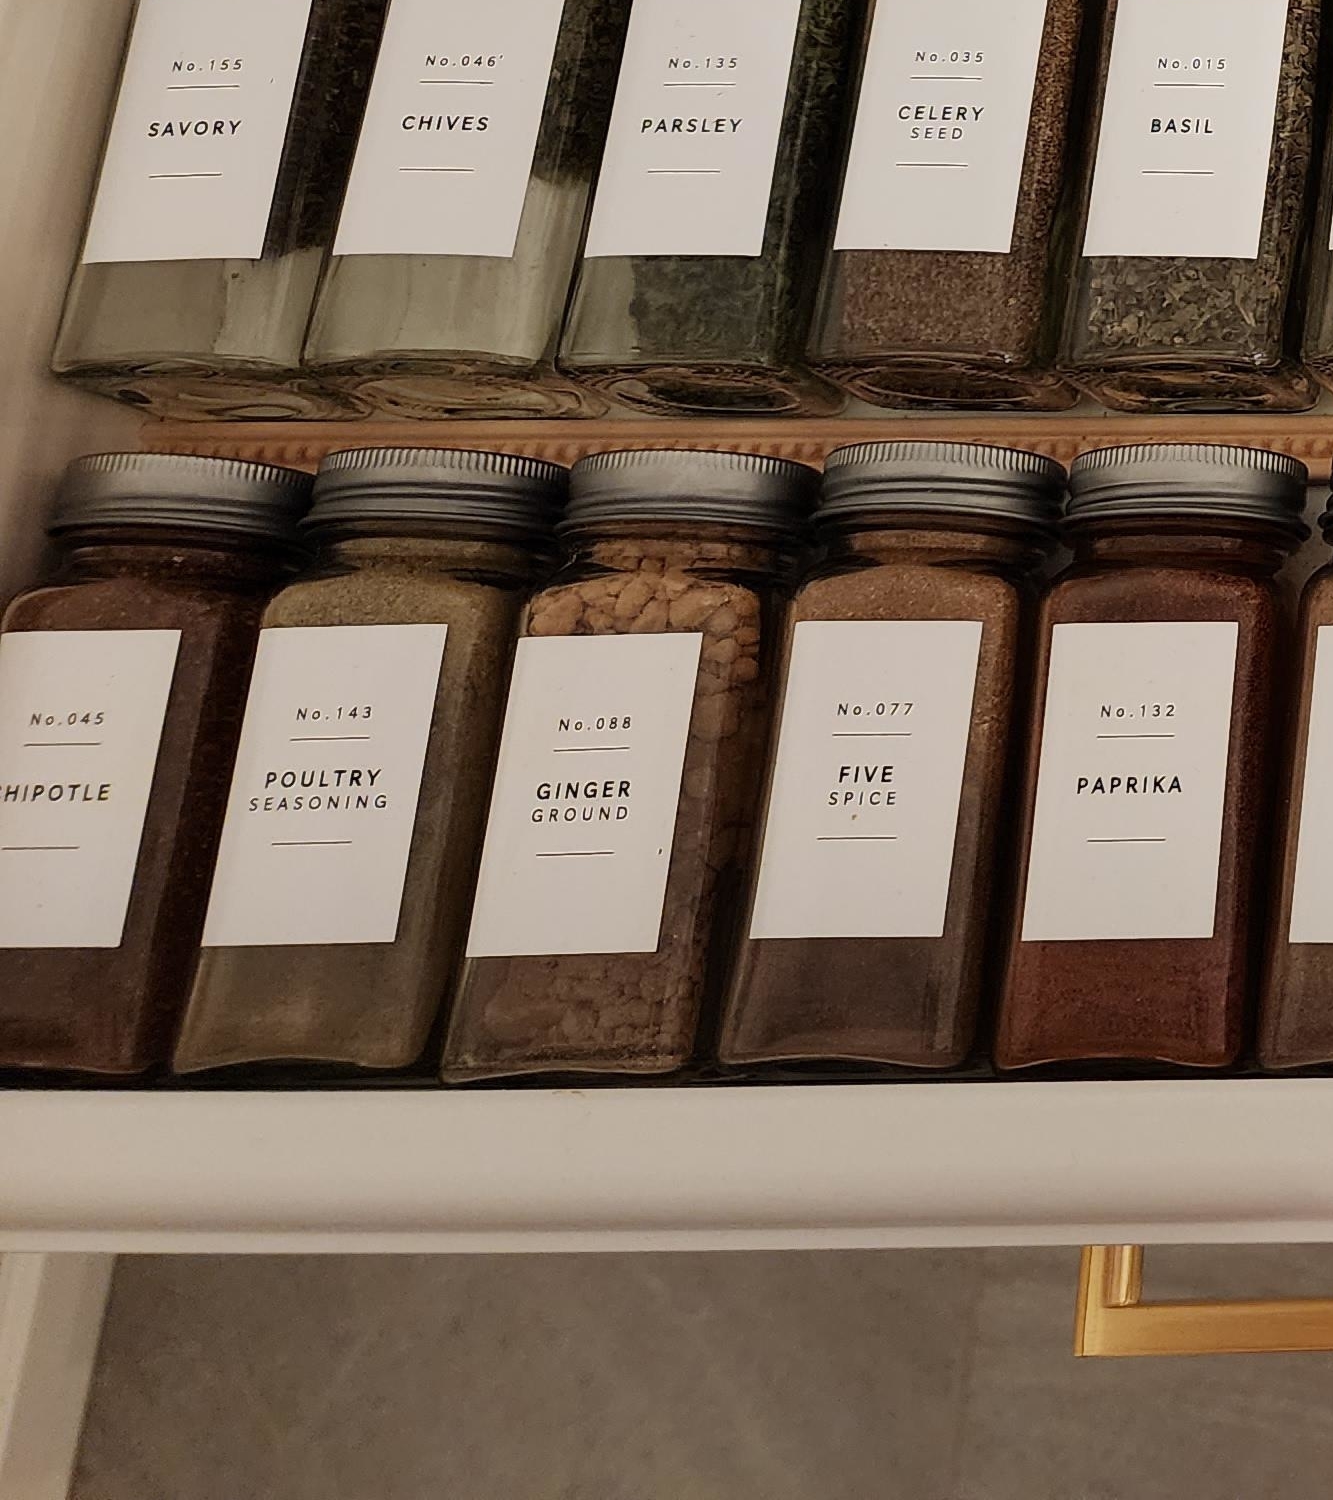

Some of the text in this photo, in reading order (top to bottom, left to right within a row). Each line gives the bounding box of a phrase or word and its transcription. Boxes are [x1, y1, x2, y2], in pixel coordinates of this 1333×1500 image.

[172, 58, 243, 72] No.155
[425, 55, 497, 68] No.046
[668, 57, 738, 69] No.135
[914, 51, 984, 63] No.035
[1157, 57, 1226, 70] No.015
[898, 105, 985, 122] CELERY
[147, 120, 242, 138] SAVORY
[401, 115, 489, 132] CHIVES
[640, 118, 743, 134] PARSLEY
[1150, 118, 1213, 134] BASIL
[910, 126, 963, 140] SEED
[296, 706, 372, 721] No.143
[837, 702, 914, 716] No.077
[1100, 704, 1175, 718] No.132
[29, 711, 105, 726] No.045
[558, 716, 631, 732] No.088
[264, 768, 382, 789] POULTRY
[838, 765, 894, 784] FIVE
[536, 780, 631, 801] GINGER
[1076, 775, 1182, 795] PAPRIKA
[248, 794, 387, 812] SEASONING
[828, 791, 897, 806] SPICE
[531, 806, 628, 823] GROUND
